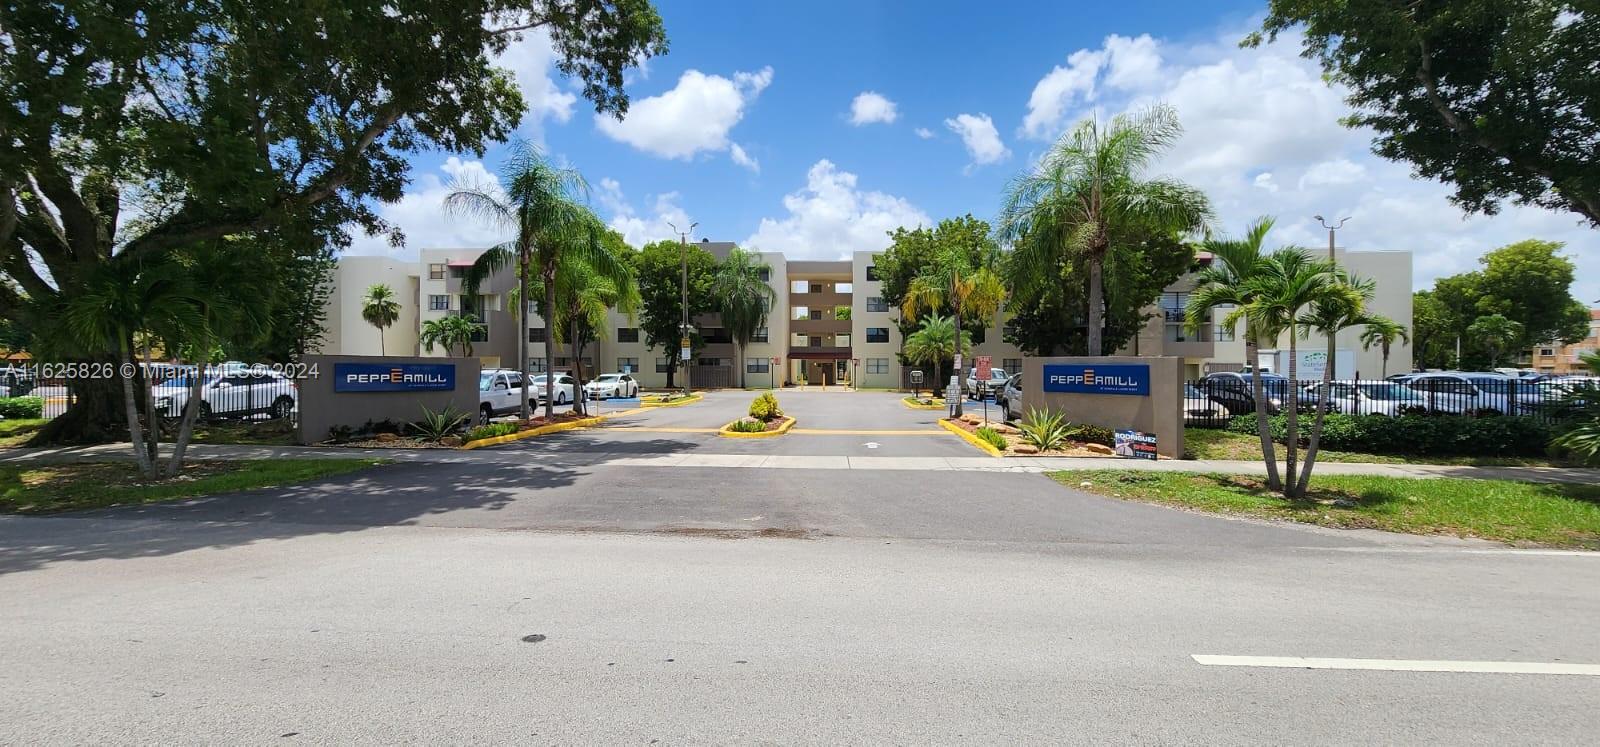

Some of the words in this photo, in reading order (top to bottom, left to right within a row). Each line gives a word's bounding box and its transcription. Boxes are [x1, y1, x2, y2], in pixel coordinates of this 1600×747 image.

[347, 368, 447, 384] PEPPERMILL
[1050, 369, 1138, 386] PEPPERMILL
[1115, 432, 1157, 443] RODRIGUEZ
